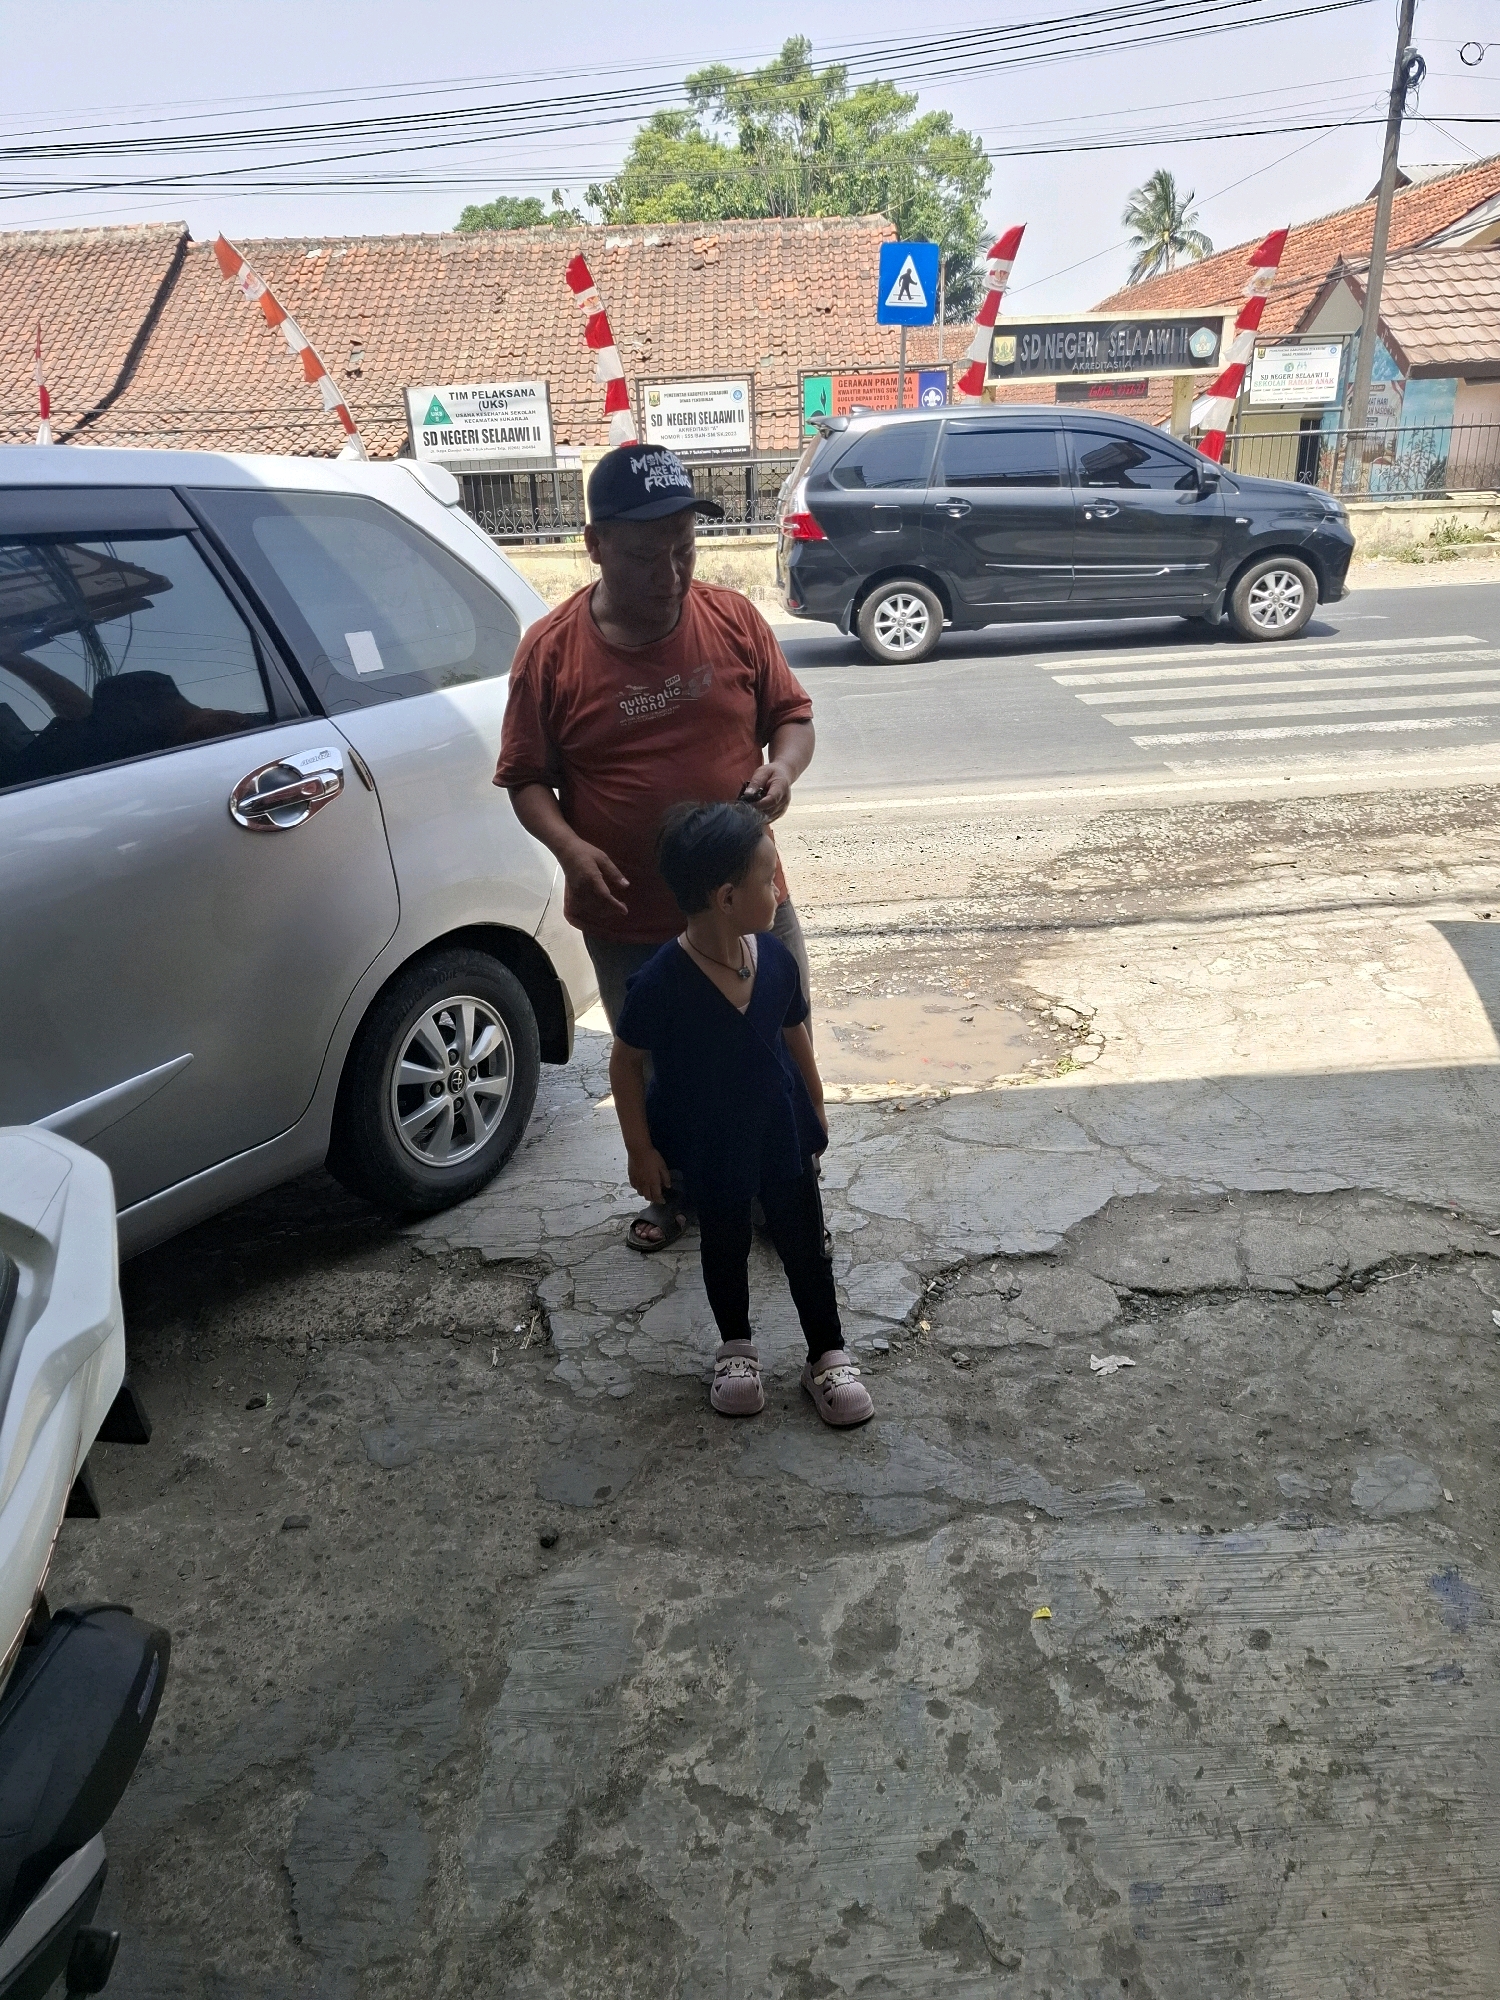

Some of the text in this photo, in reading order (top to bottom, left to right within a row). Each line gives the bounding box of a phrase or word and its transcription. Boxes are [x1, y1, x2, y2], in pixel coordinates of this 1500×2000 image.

[1021, 334, 1041, 361] SD
[1044, 331, 1099, 360] NEGERI
[1108, 328, 1175, 357] SELAAWI
[1072, 361, 1123, 370] AKREDITASI
[838, 378, 873, 388] GERAKAN
[1254, 379, 1286, 387] SEKOLAH
[1288, 378, 1313, 386] RAMAH
[449, 388, 536, 400] TIM PELAKSANA
[478, 400, 508, 411] (UKS)
[837, 406, 847, 416] SD
[651, 409, 745, 427] SD NEGERI SELAAWI II
[422, 426, 541, 446] SD NEGERI SELAAWI II
[649, 465, 681, 477] ARE MY
